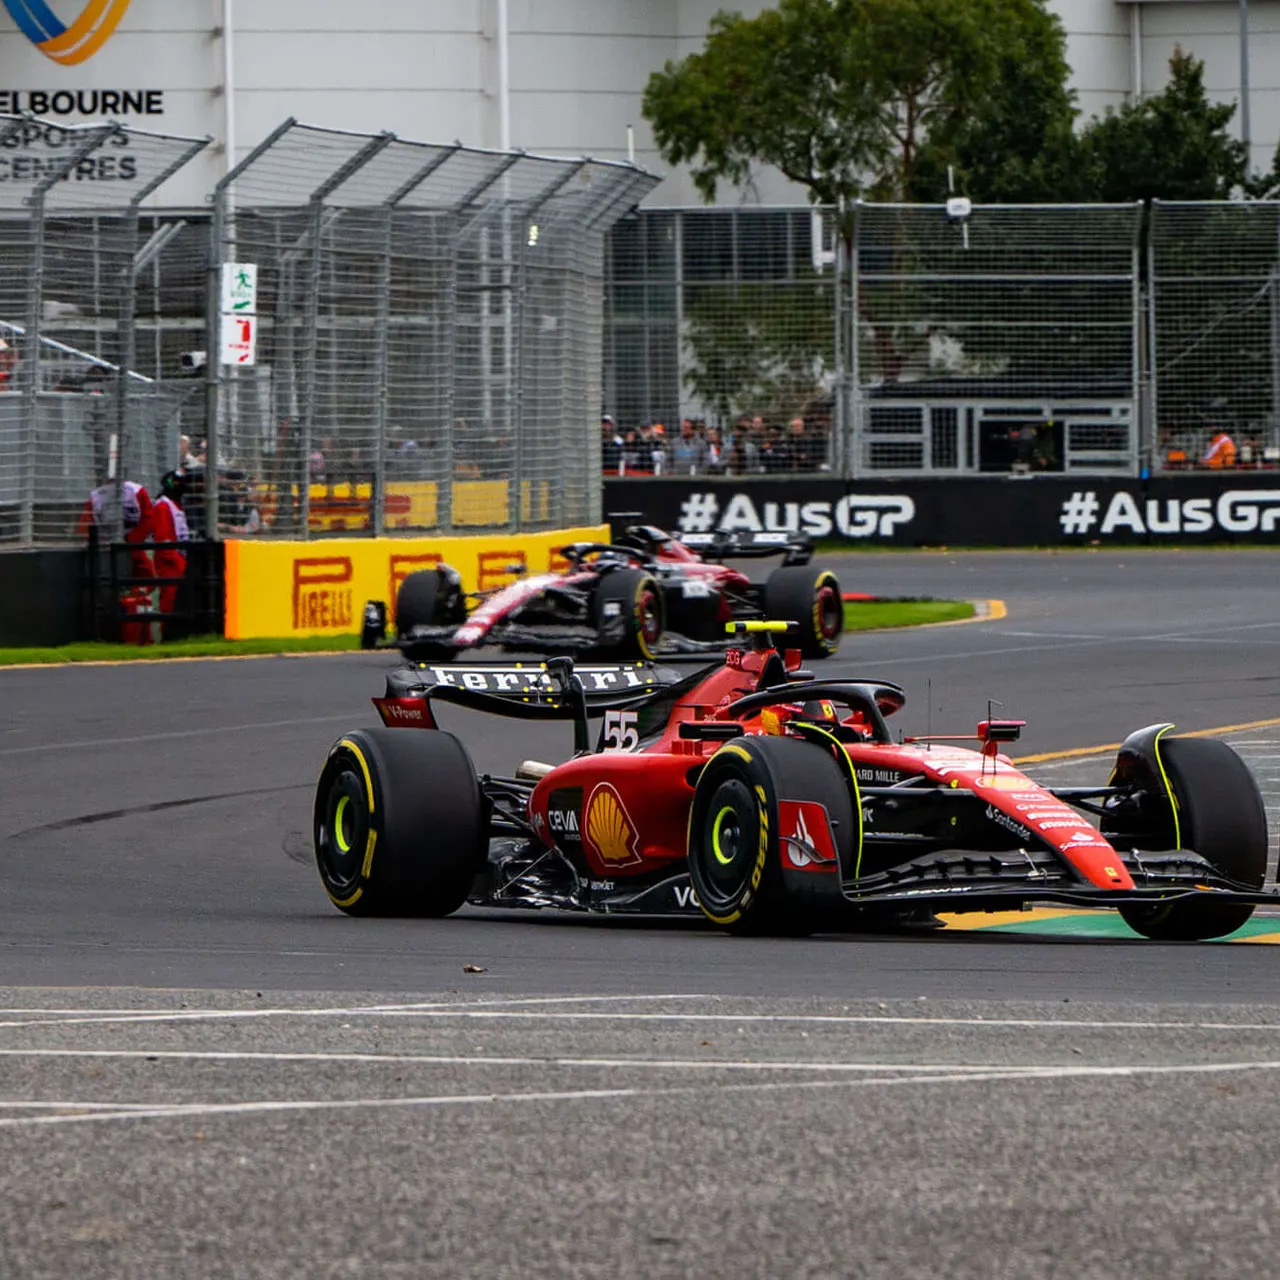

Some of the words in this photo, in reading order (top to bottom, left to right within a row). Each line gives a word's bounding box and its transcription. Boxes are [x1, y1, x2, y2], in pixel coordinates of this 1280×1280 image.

[0, 123, 129, 148] SPORS
[679, 493, 915, 537] #AusGP
[429, 666, 642, 690] Ferrri
[388, 705, 422, 720] V-Power
[604, 710, 639, 753] 55
[875, 770, 900, 783] MILLE
